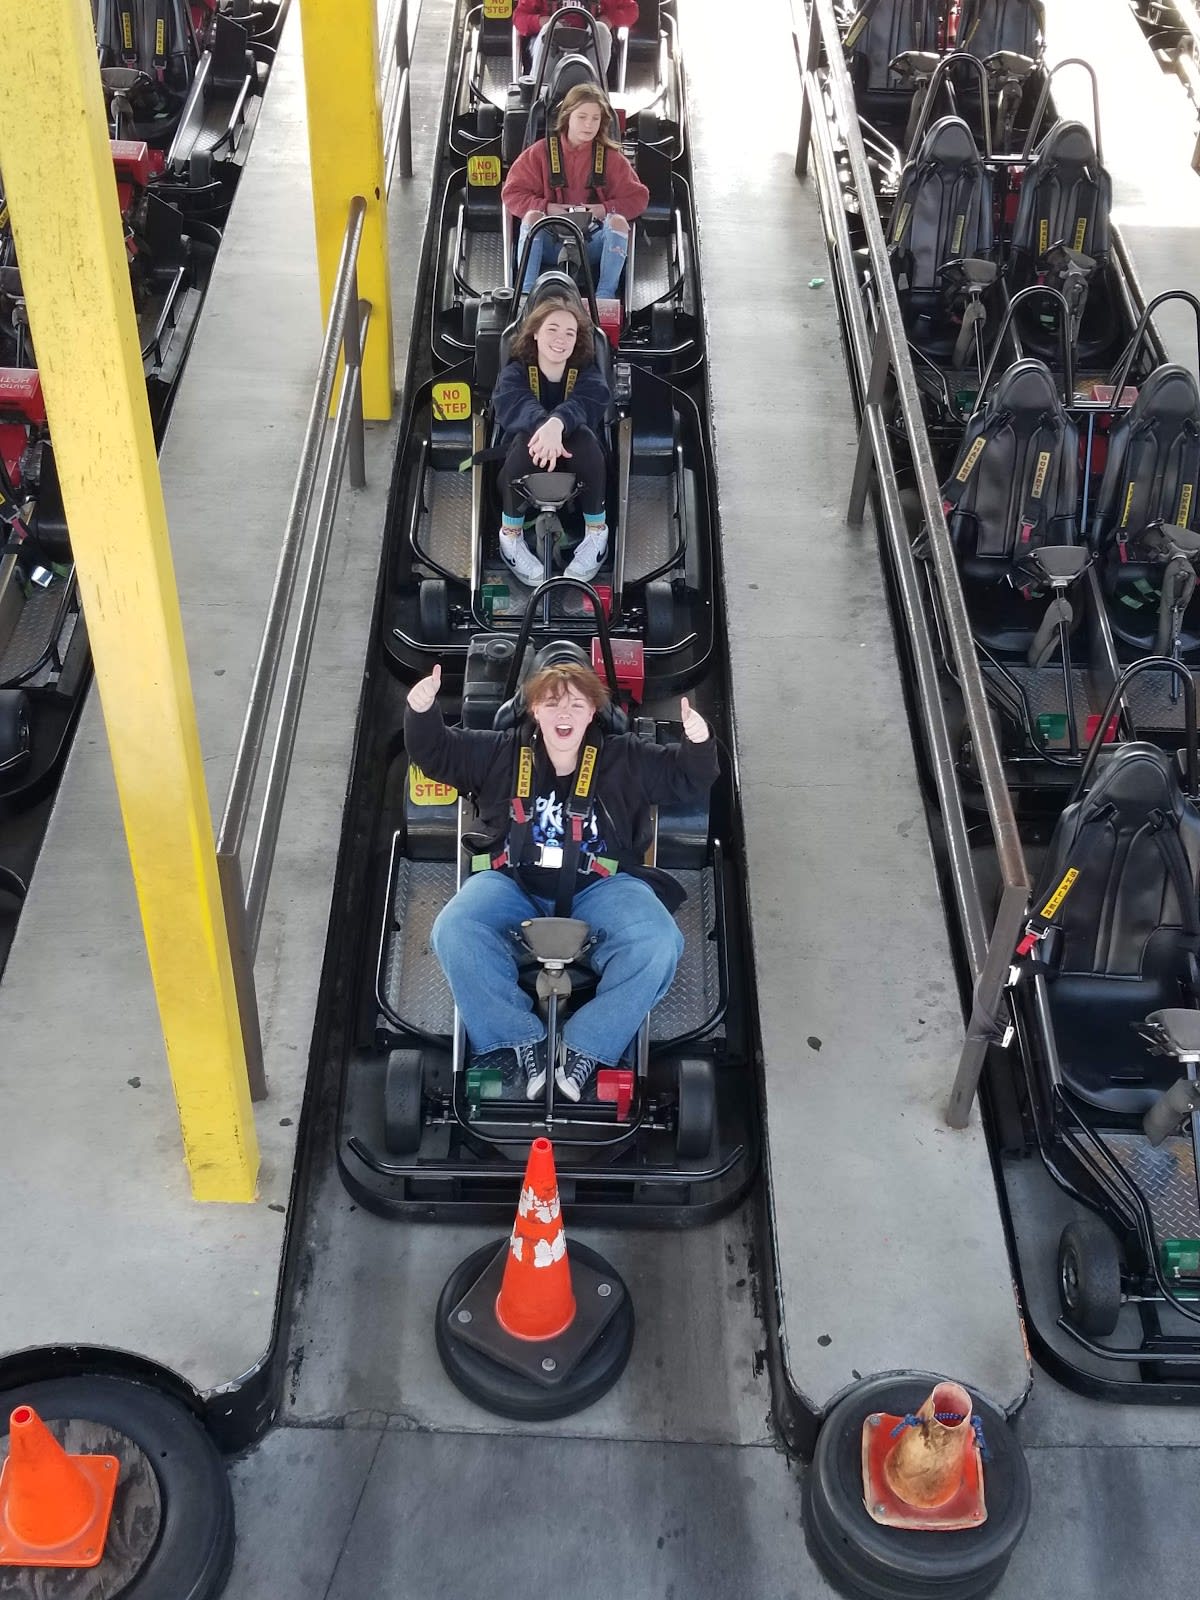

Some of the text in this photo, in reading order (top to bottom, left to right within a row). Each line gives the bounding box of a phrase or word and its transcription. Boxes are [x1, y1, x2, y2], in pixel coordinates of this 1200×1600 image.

[487, 6, 510, 14] STEP
[477, 161, 492, 170] NO
[471, 172, 497, 181] STEP
[442, 390, 460, 400] NO
[597, 657, 639, 667] CAUTN
[520, 748, 531, 796] SHALLER
[577, 747, 596, 794] GOKARTS
[415, 783, 453, 797] STEP
[1044, 870, 1078, 917] SHALLER
